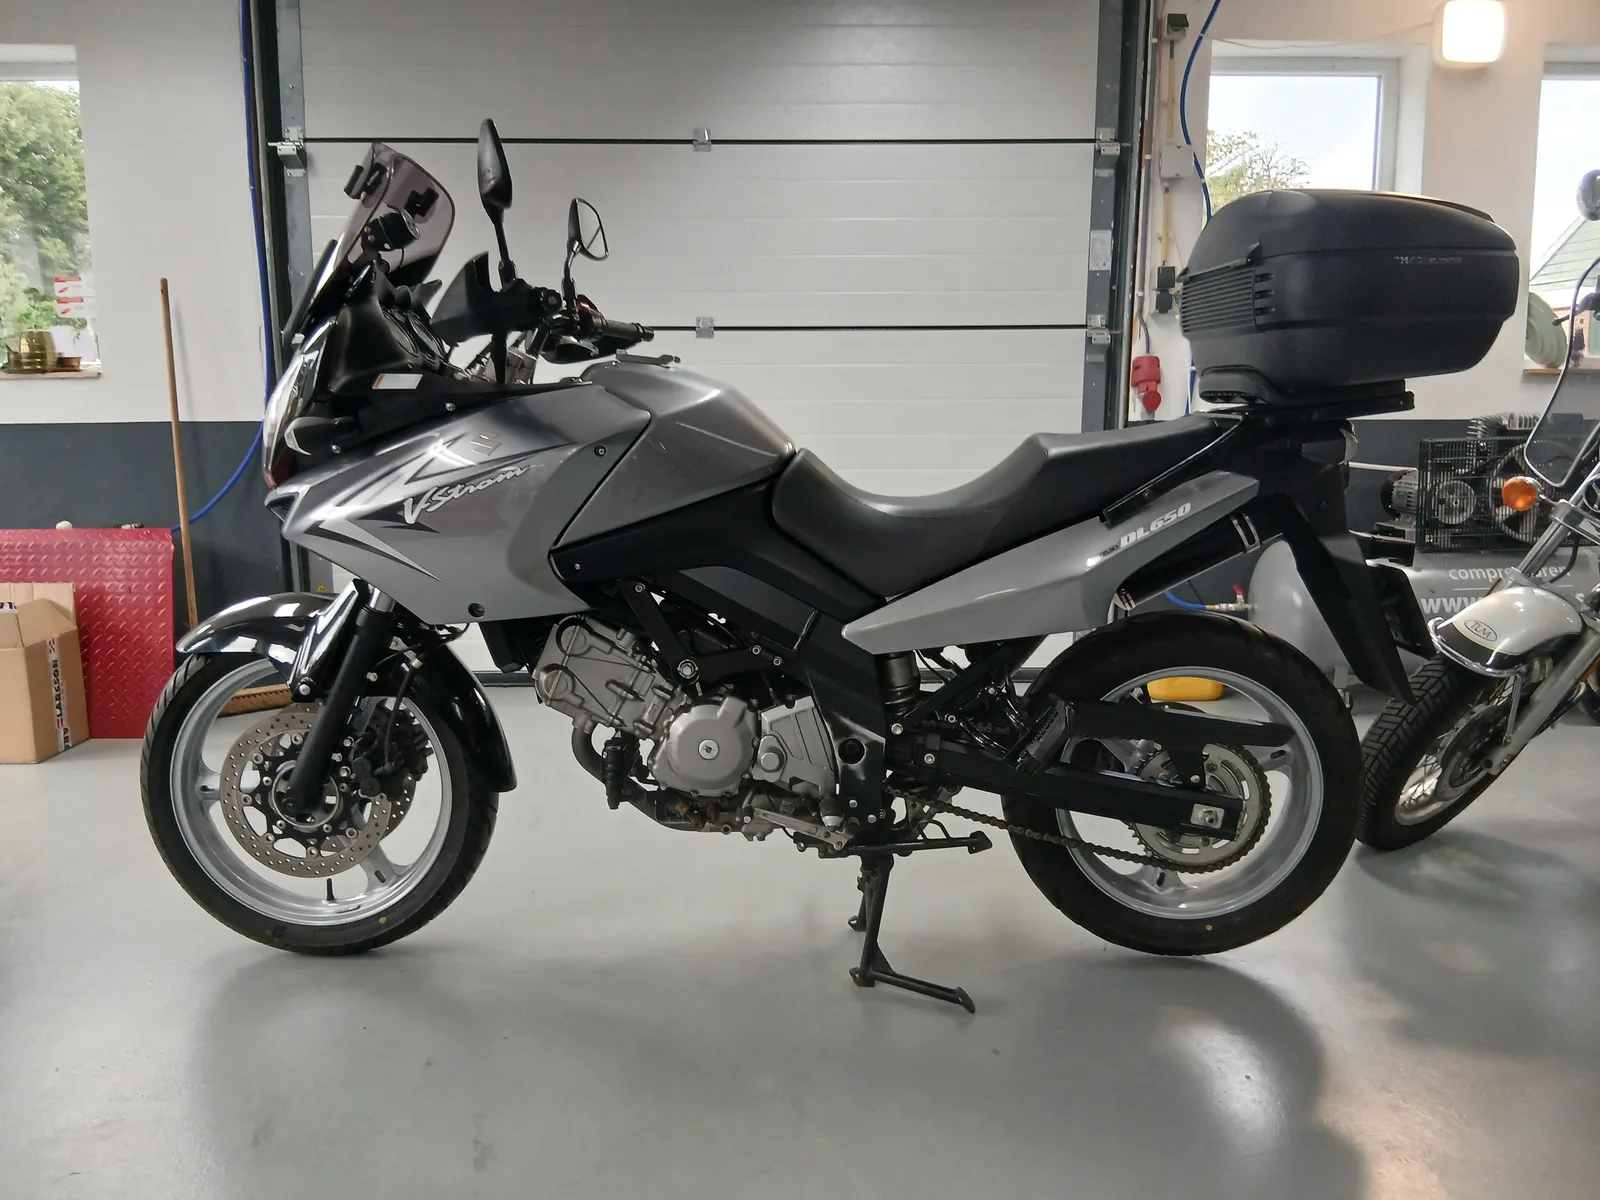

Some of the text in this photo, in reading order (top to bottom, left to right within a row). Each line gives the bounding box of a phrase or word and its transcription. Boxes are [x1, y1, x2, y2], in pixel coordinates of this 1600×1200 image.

[1119, 502, 1191, 549] DL650
[1470, 620, 1492, 639] TLM
[51, 660, 63, 718] LARSSON
